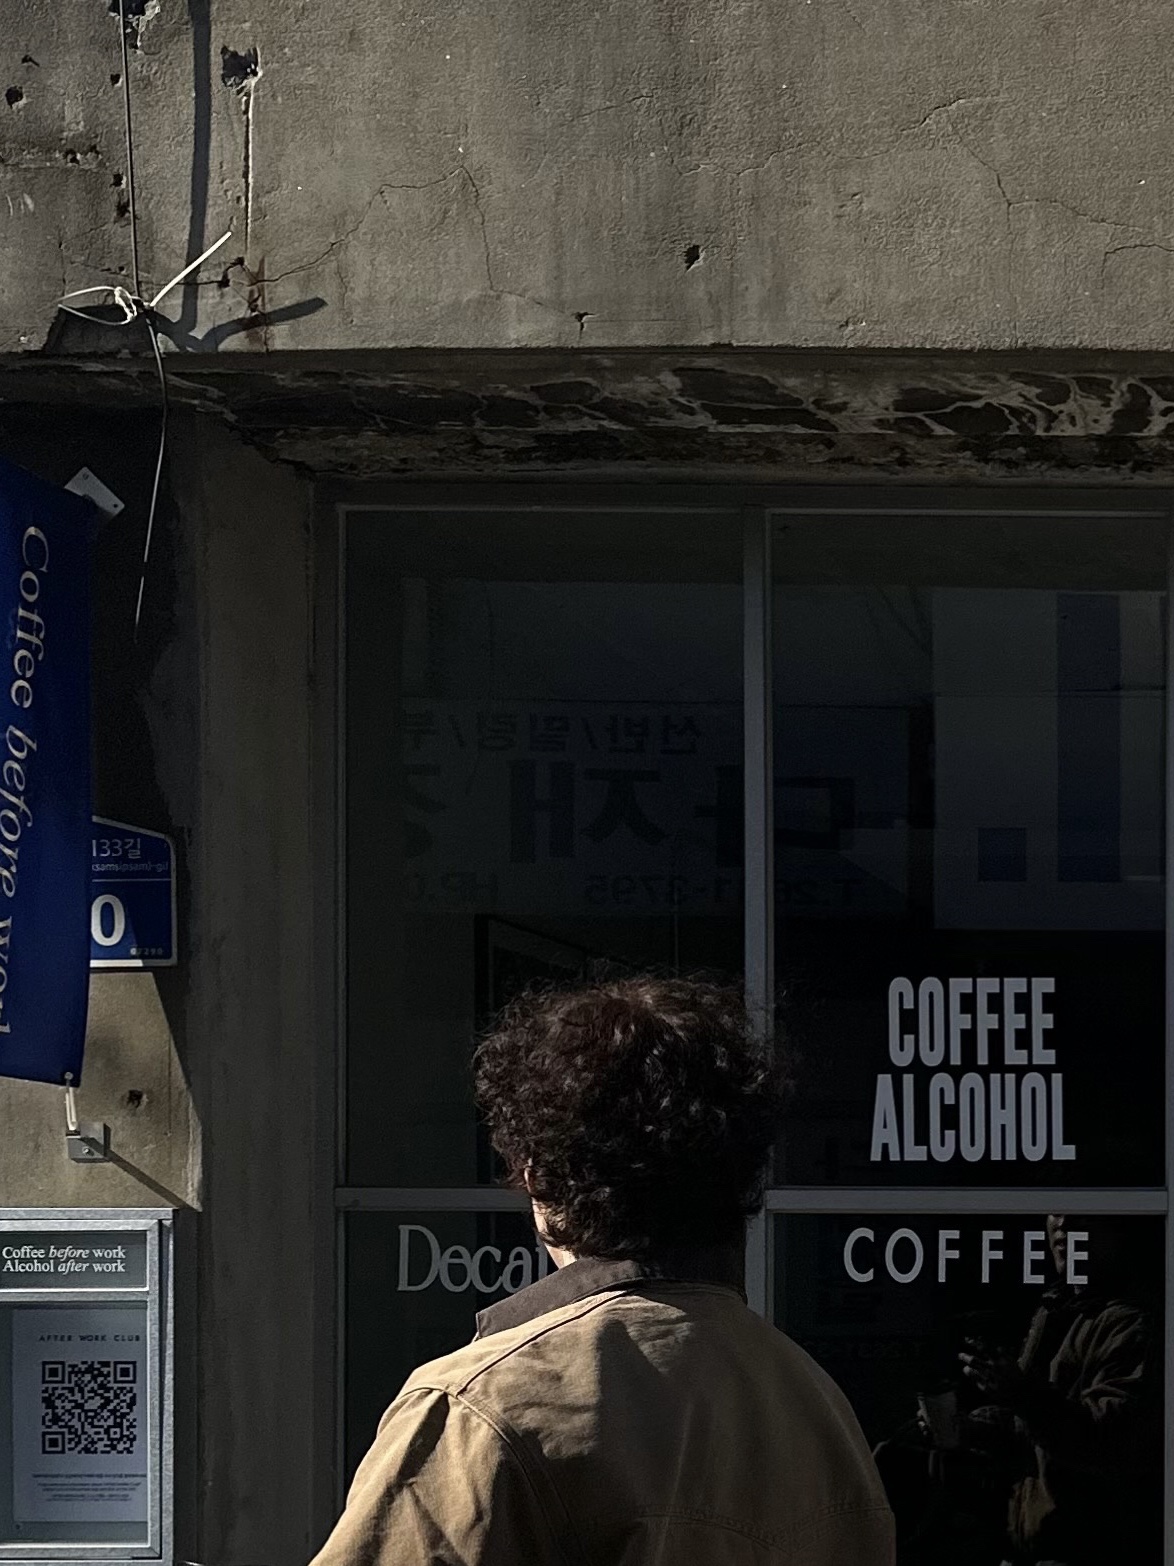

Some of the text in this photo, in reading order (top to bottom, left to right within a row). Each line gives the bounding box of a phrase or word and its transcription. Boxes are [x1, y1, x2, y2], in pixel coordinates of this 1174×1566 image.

[10, 526, 49, 709] Coffee
[887, 976, 1057, 1067] COFFEE
[869, 1072, 1077, 1163] ALCOHOL
[2, 1245, 126, 1261] Coffee before work
[2, 1260, 126, 1275] Alcohol after work
[842, 1228, 1090, 1286] COFFEE
[39, 1334, 140, 1342] AFTER WORK CLUB
